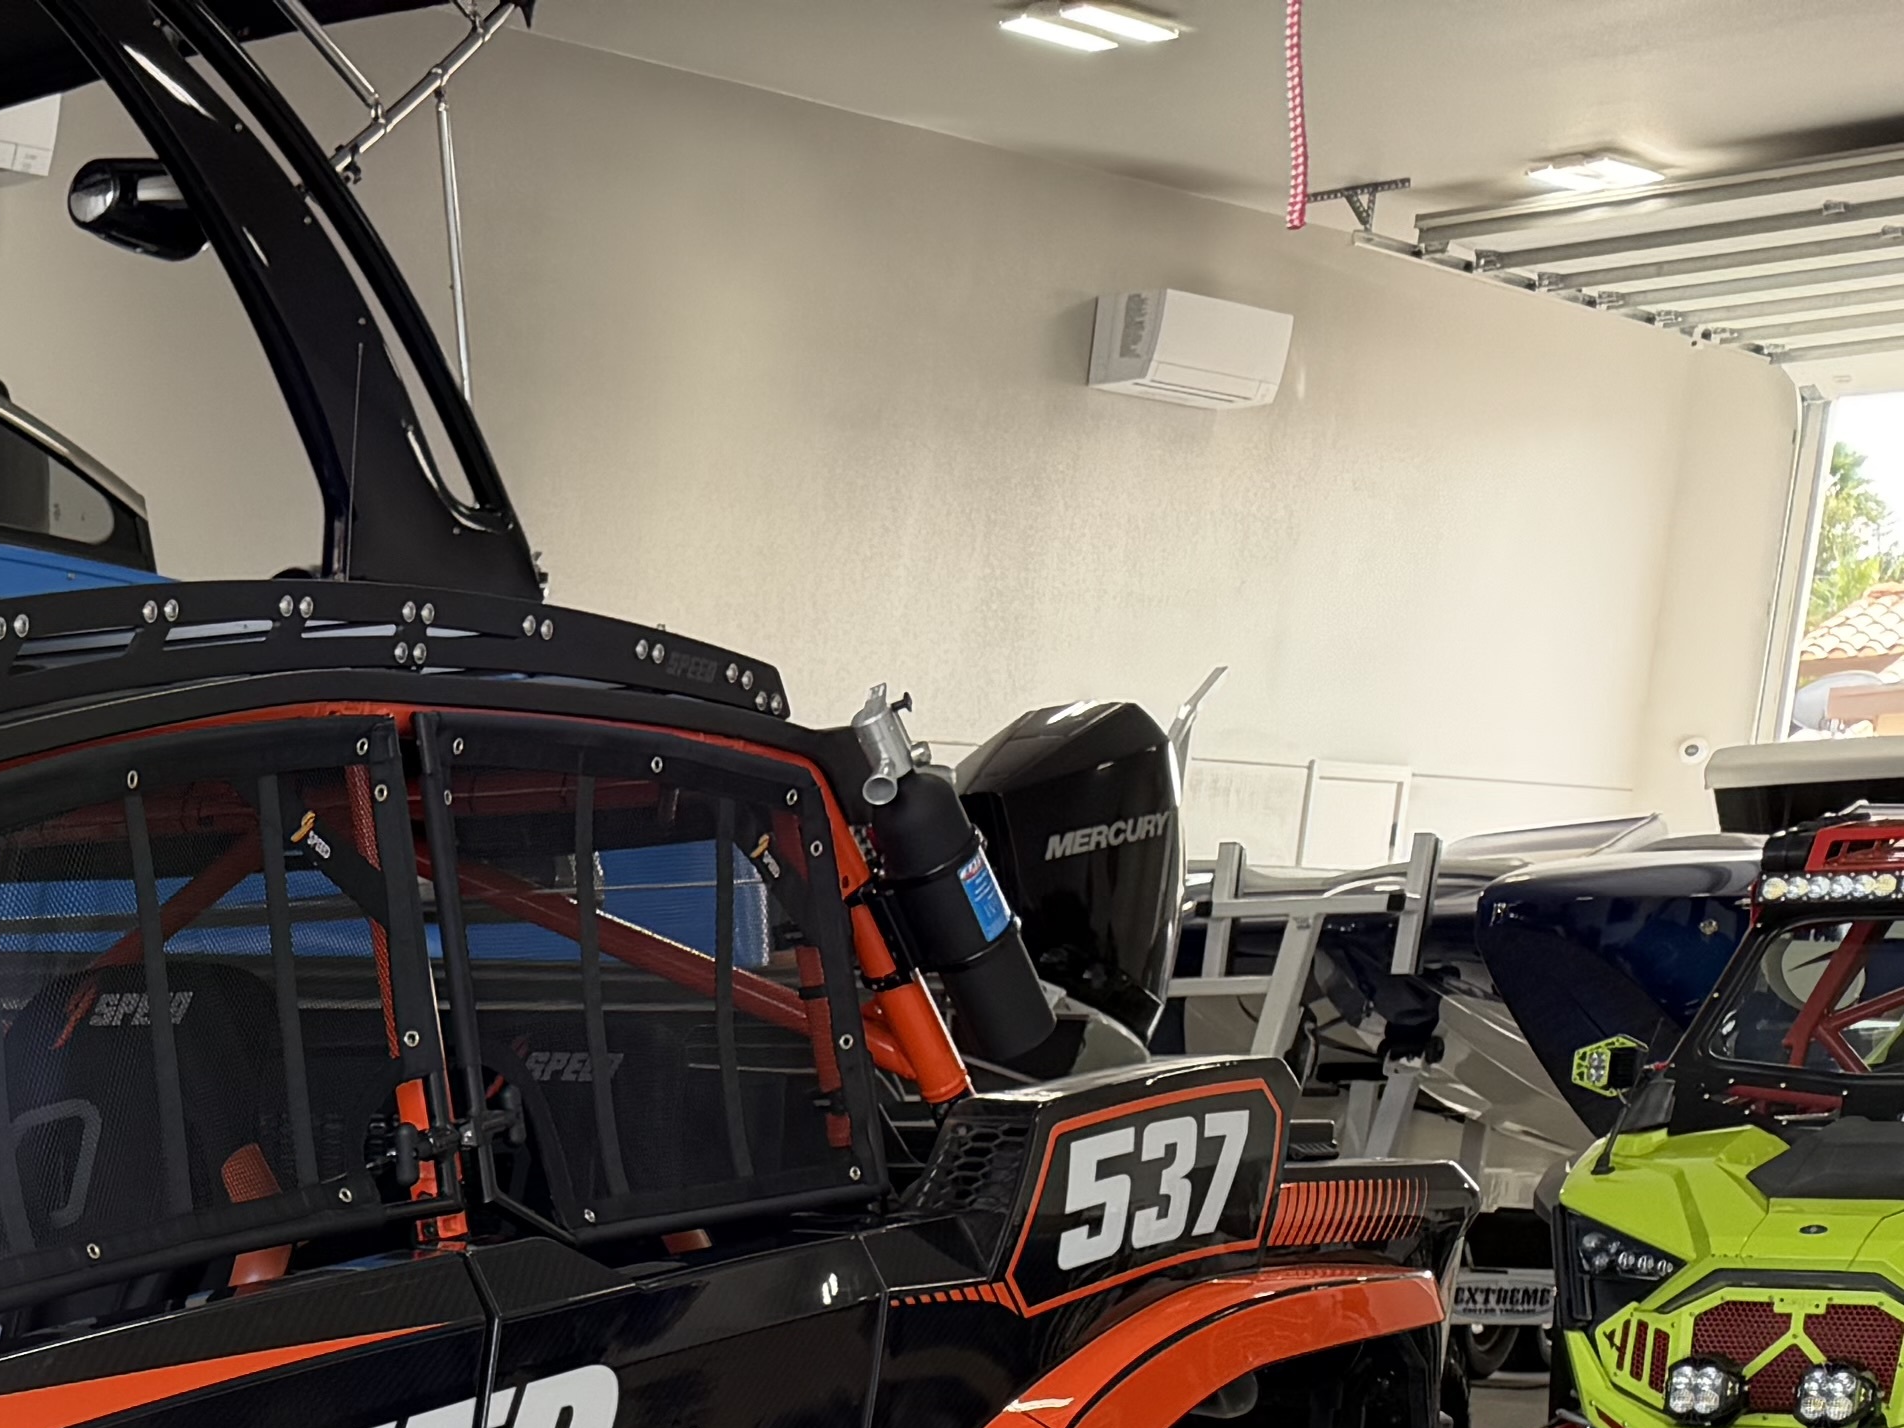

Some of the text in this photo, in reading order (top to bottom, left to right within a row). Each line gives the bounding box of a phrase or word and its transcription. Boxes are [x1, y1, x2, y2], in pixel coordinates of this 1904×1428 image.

[1045, 811, 1170, 861] MERCURY
[89, 991, 193, 1026] SPED
[1057, 1109, 1250, 1271] 537
[1454, 1286, 1551, 1307] EXTREME
